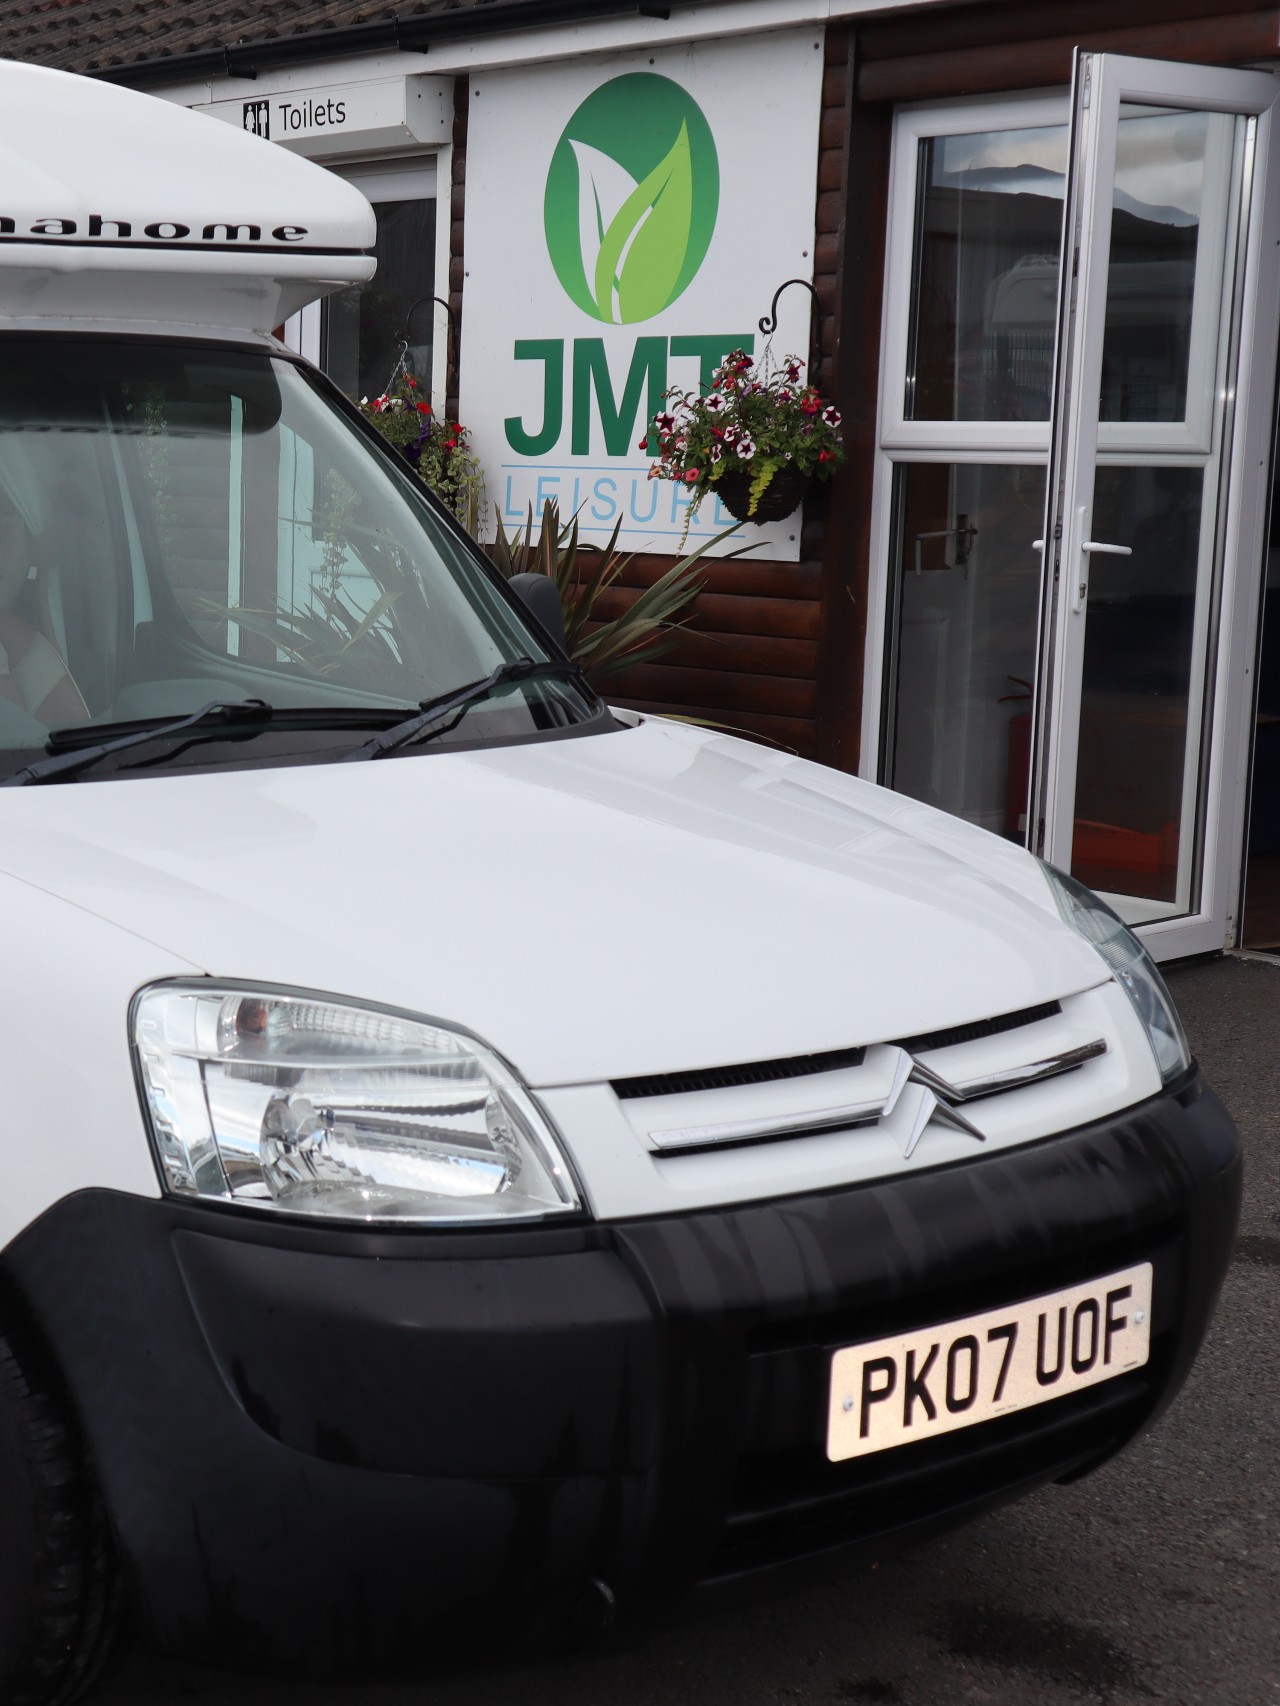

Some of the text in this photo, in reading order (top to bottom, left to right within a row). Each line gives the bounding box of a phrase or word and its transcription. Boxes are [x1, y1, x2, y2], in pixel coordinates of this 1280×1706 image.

[279, 98, 346, 131] Toilets
[504, 334, 755, 457] JMT
[859, 1284, 1133, 1439] PK07 UOF
